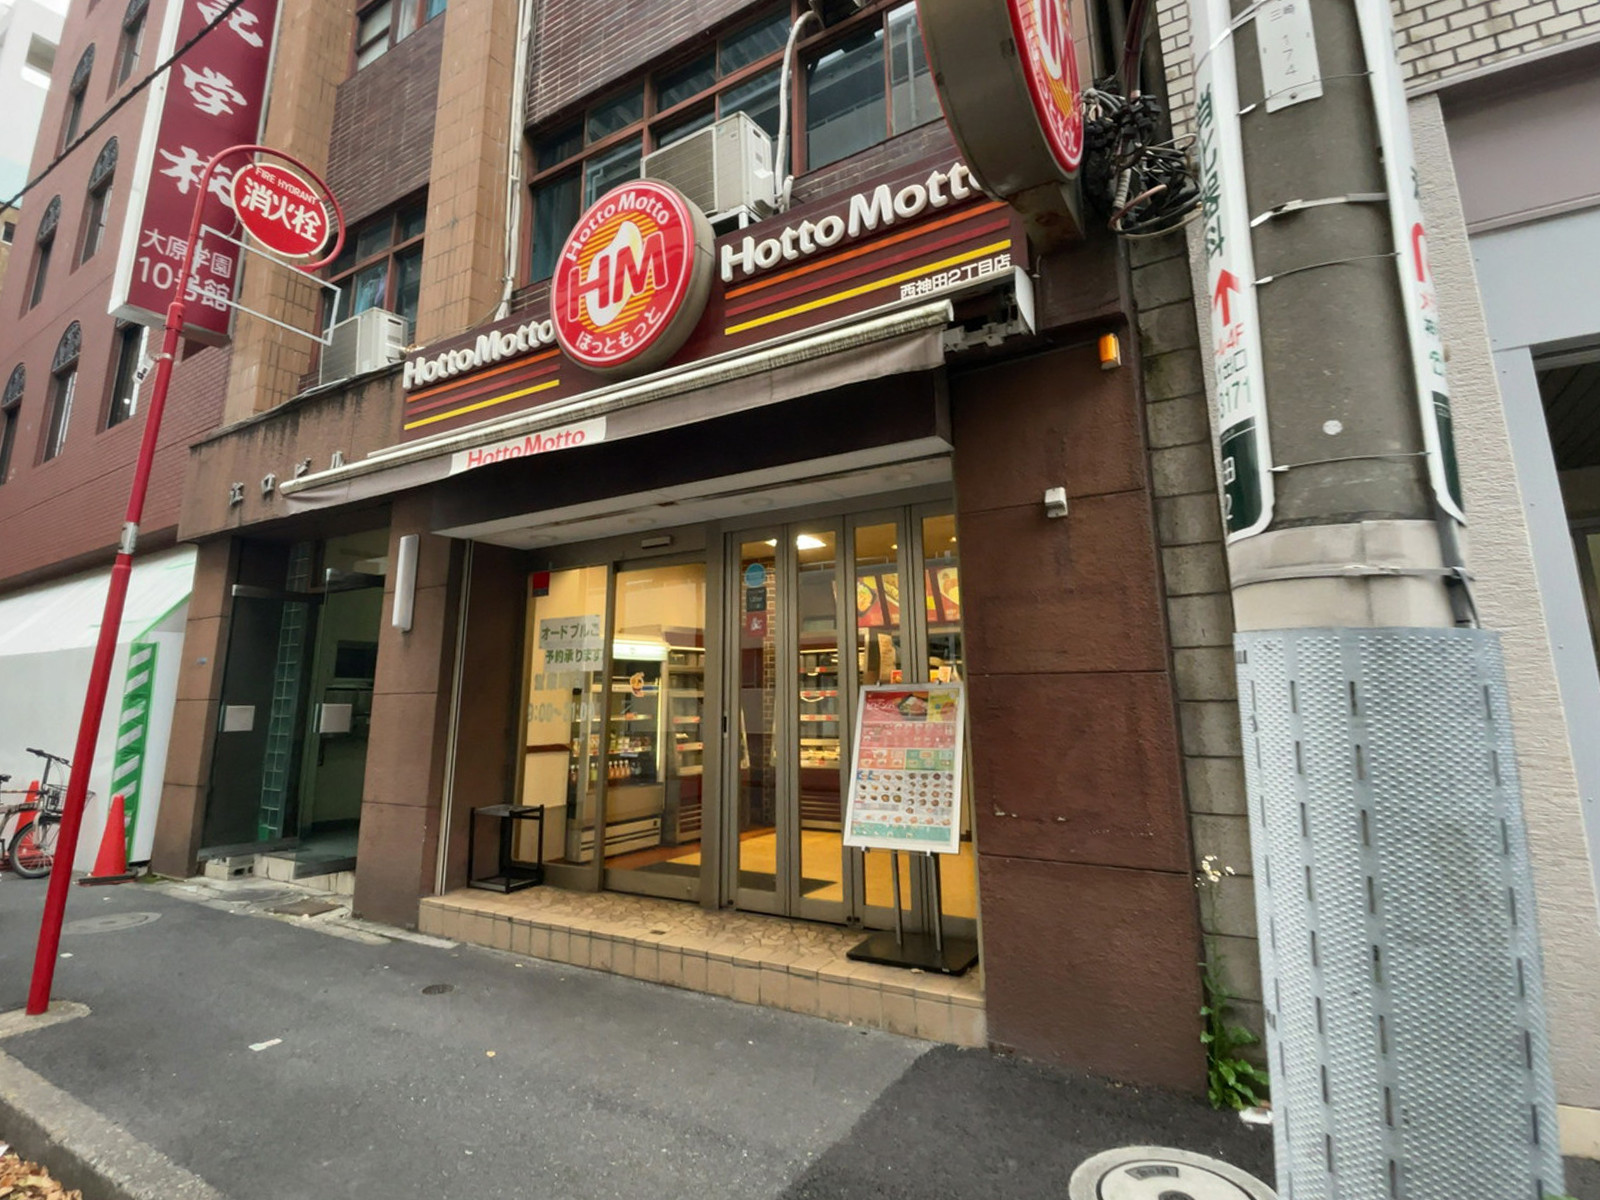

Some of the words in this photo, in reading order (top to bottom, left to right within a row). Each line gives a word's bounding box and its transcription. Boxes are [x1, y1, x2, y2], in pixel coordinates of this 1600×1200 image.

[255, 167, 276, 185] FIRE
[277, 179, 317, 206] HYDRANT
[240, 176, 322, 243] 消火栓
[576, 306, 661, 354] ほっともっと
[546, 648, 602, 665] 予約承ります
